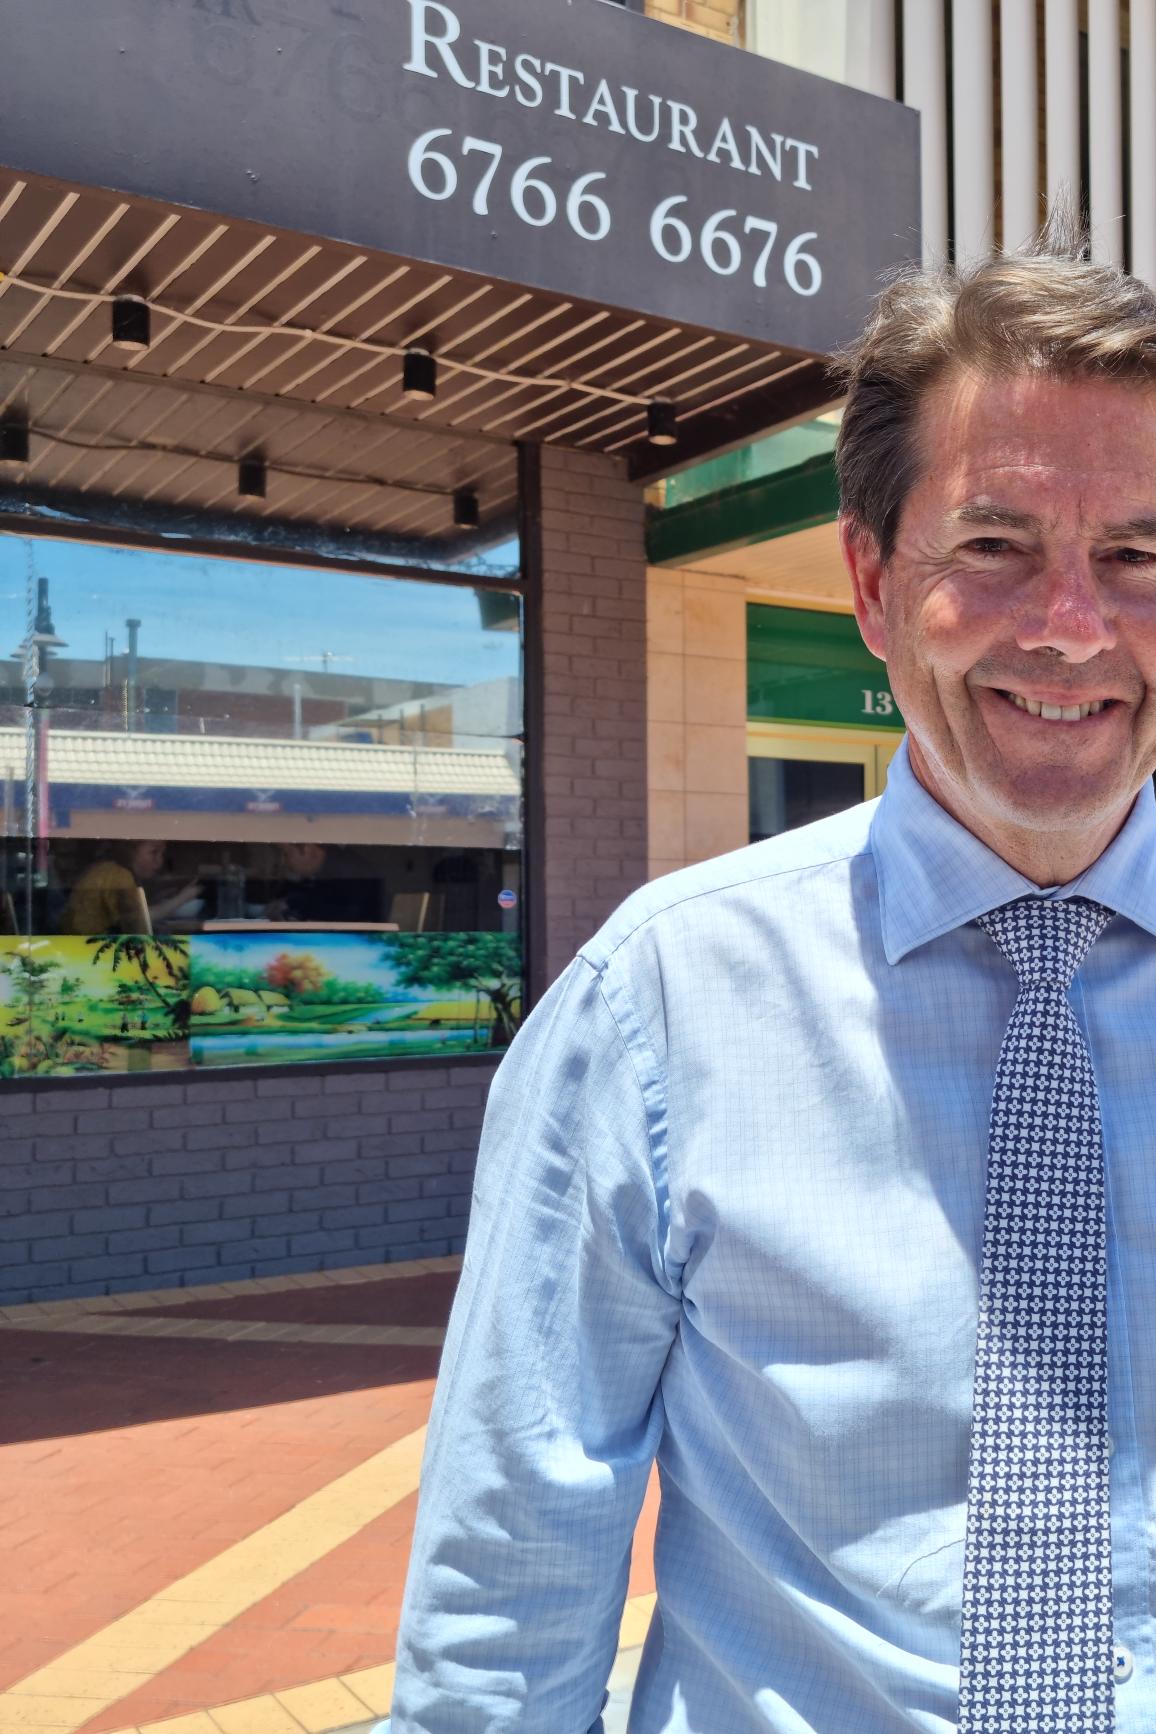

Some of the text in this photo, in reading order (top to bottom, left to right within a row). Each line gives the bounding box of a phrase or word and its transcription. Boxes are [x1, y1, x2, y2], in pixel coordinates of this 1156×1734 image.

[408, 128, 822, 296] 6766 6676
[861, 690, 893, 715] 13
